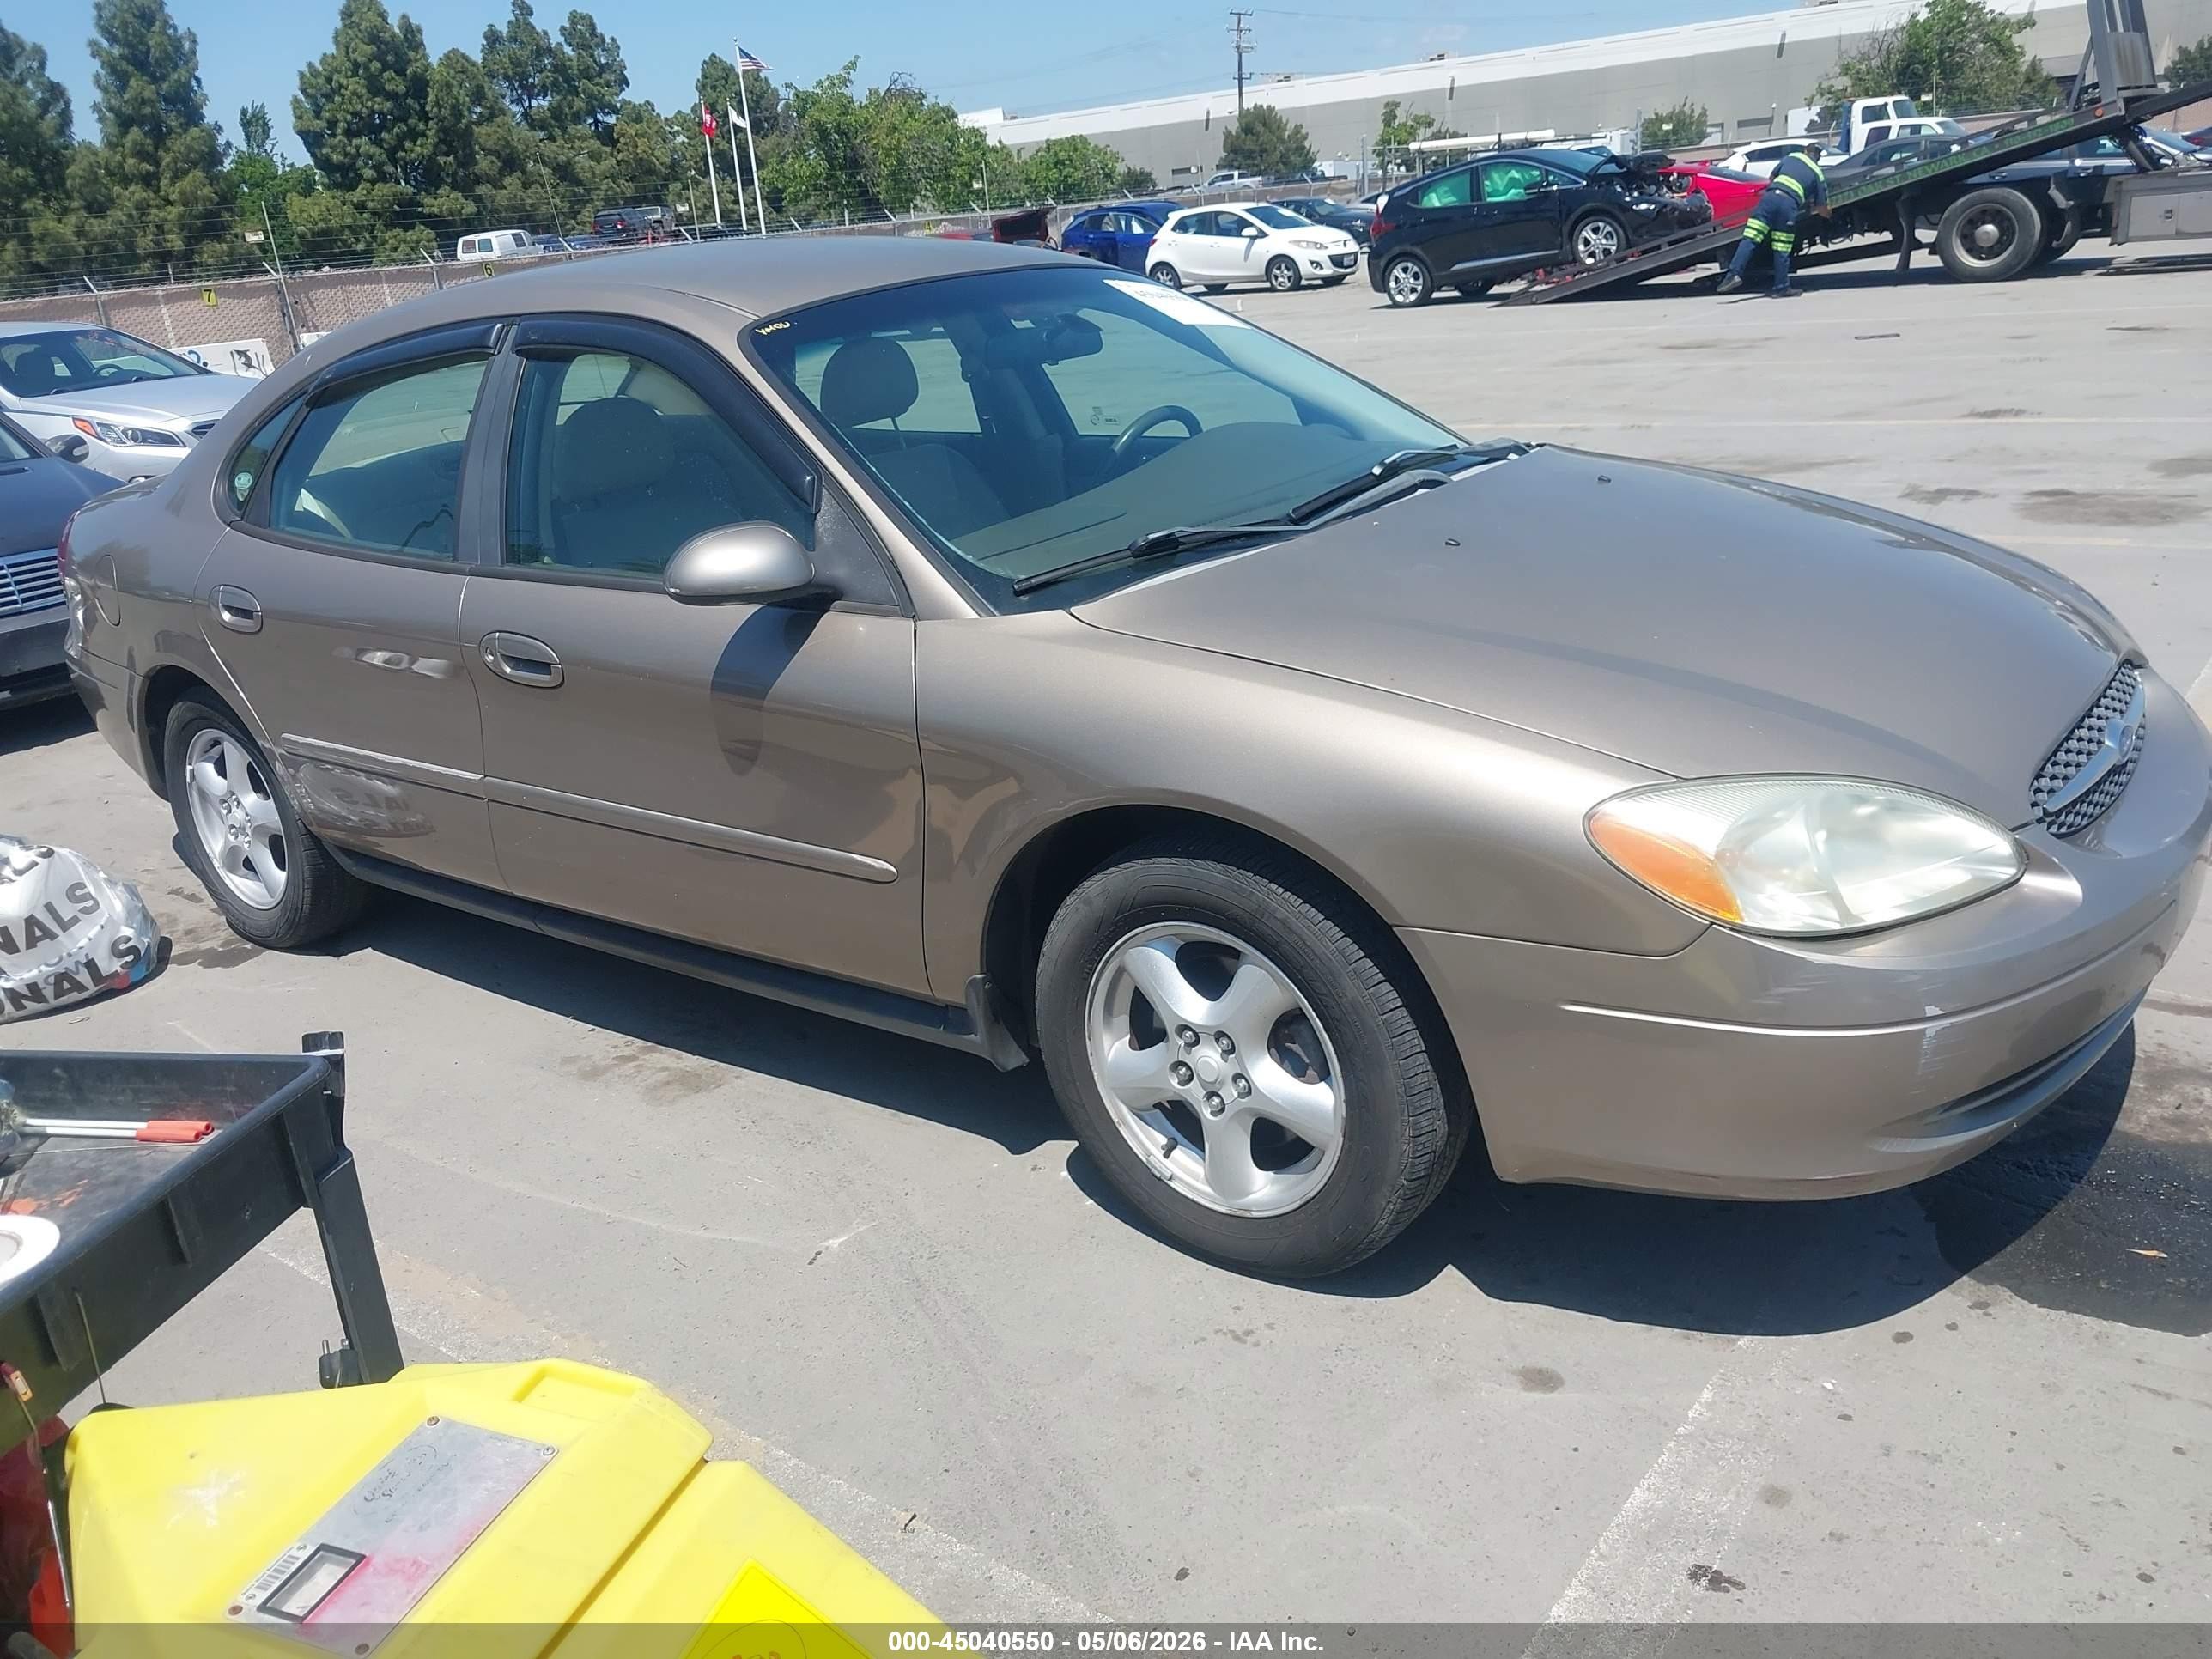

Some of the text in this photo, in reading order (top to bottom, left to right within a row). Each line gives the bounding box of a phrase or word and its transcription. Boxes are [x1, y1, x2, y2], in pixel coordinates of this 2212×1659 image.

[484, 263, 493, 276] 6
[203, 289, 213, 303] 7
[0, 934, 142, 1014] NALS
